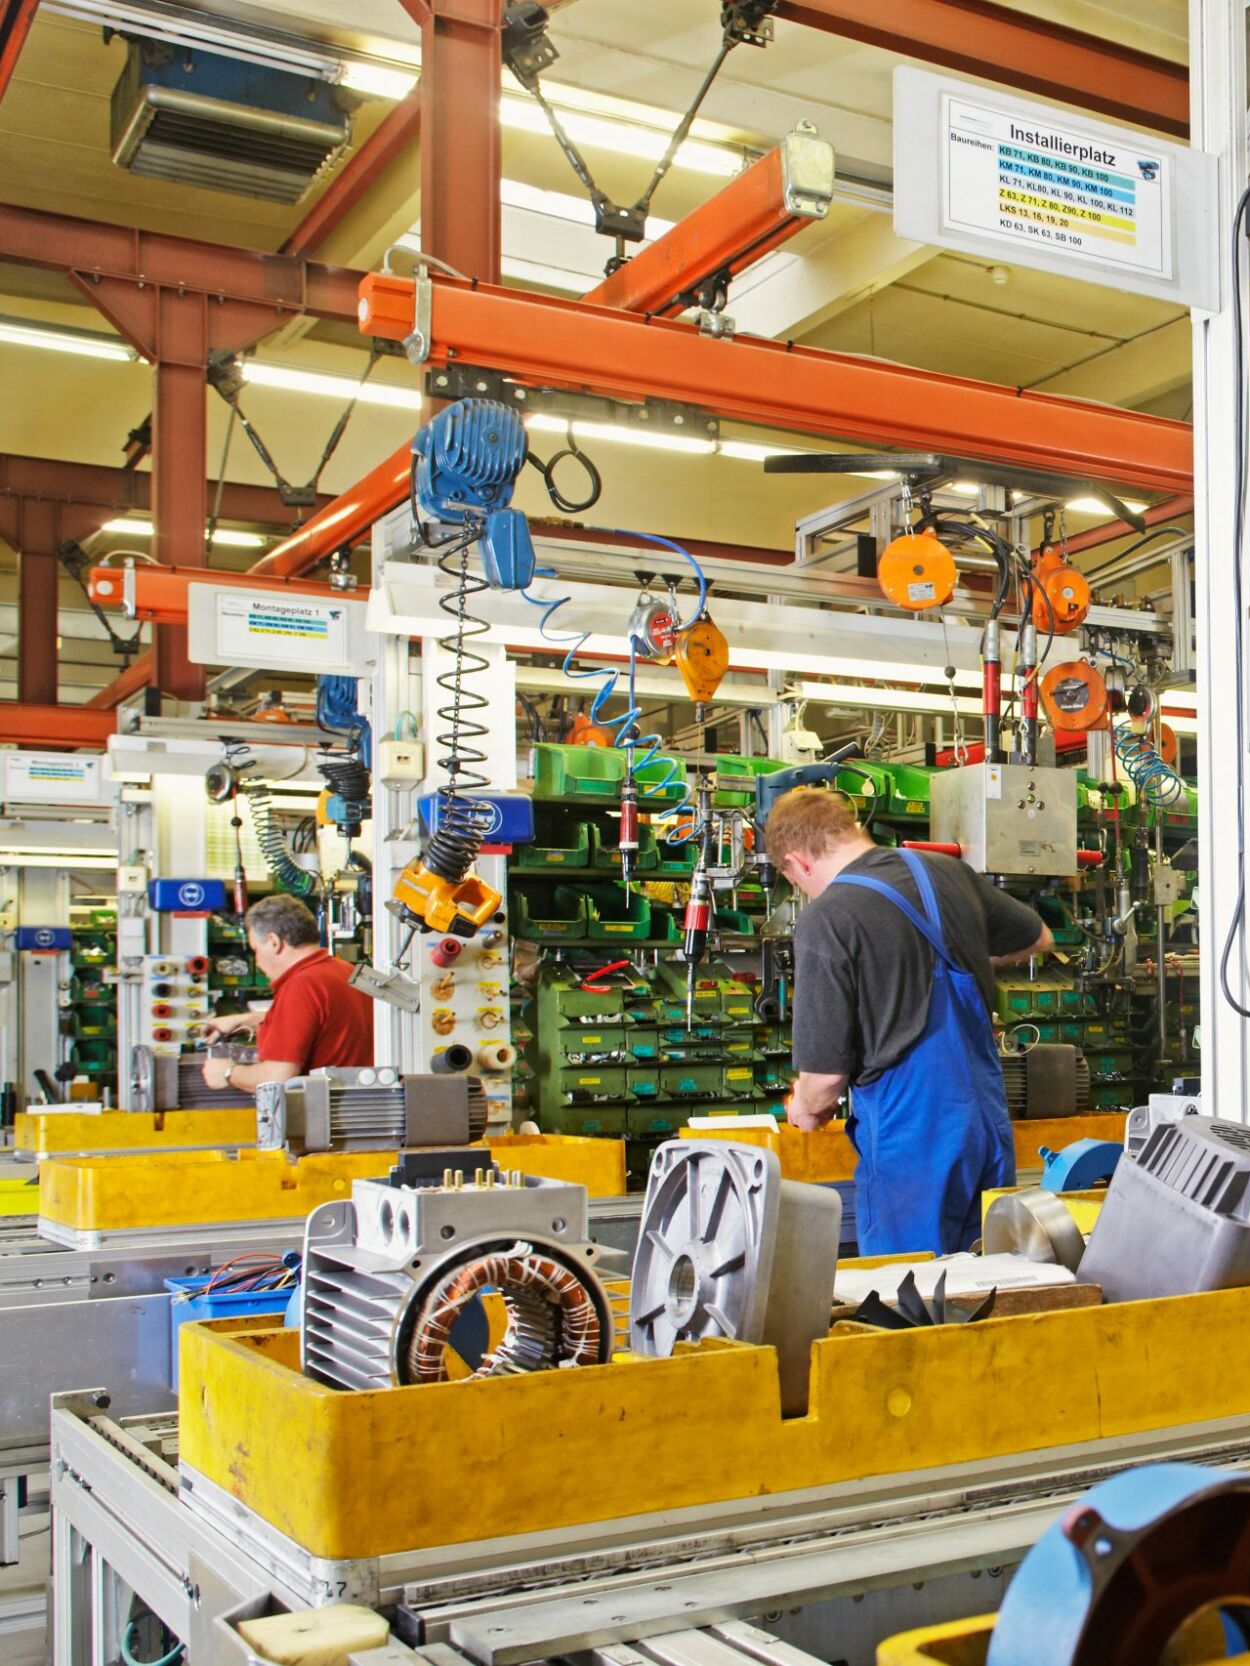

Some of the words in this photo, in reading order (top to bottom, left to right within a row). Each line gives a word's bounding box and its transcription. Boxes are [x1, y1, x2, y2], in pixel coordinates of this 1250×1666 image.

[950, 132, 995, 152] Baureihen:
[1010, 124, 1116, 167] Installierplatz
[999, 145, 1011, 156] KB
[1013, 149, 1025, 161] 71,
[1027, 153, 1039, 163] KB
[1041, 157, 1053, 168] 80,
[1055, 161, 1067, 171] KB
[1068, 164, 1080, 175] 90,
[1082, 168, 1094, 178] KB
[1096, 172, 1109, 182] 100
[999, 160, 1013, 171] KM
[1014, 165, 1027, 176] 71,
[1028, 168, 1042, 178] KM
[1043, 172, 1055, 183] 80,
[1057, 175, 1070, 186] KM
[1071, 179, 1083, 190] 90,
[1085, 183, 1098, 193] KM
[1100, 187, 1113, 197] 100
[999, 174, 1011, 185] KL
[1013, 177, 1025, 189] 71,
[1051, 188, 1062, 198] KL
[1063, 191, 1075, 202] 90,
[1077, 195, 1088, 205] KL
[1090, 199, 1105, 210] 100,
[1107, 203, 1118, 213] KL
[1120, 207, 1133, 216] 112
[999, 189, 1005, 198] Z
[1007, 191, 1019, 201] 63,
[1020, 194, 1026, 203] Z
[1027, 196, 1040, 207] 71,
[1041, 199, 1047, 208] Z
[1049, 201, 1061, 212] 80,
[1080, 209, 1086, 218] Z
[1088, 212, 1101, 222] 100
[999, 203, 1016, 214] LKS
[1019, 208, 1030, 219] 13,
[1033, 212, 1044, 222] 16,
[1046, 215, 1058, 226] 19,
[1059, 218, 1069, 228] 20
[999, 219, 1012, 229] KD
[1014, 222, 1026, 233] 63,
[1027, 225, 1040, 235] SK
[1041, 228, 1053, 239] 63,
[1055, 232, 1067, 242] SB
[1069, 235, 1082, 245] 100
[252, 602, 313, 616] Montageplatz
